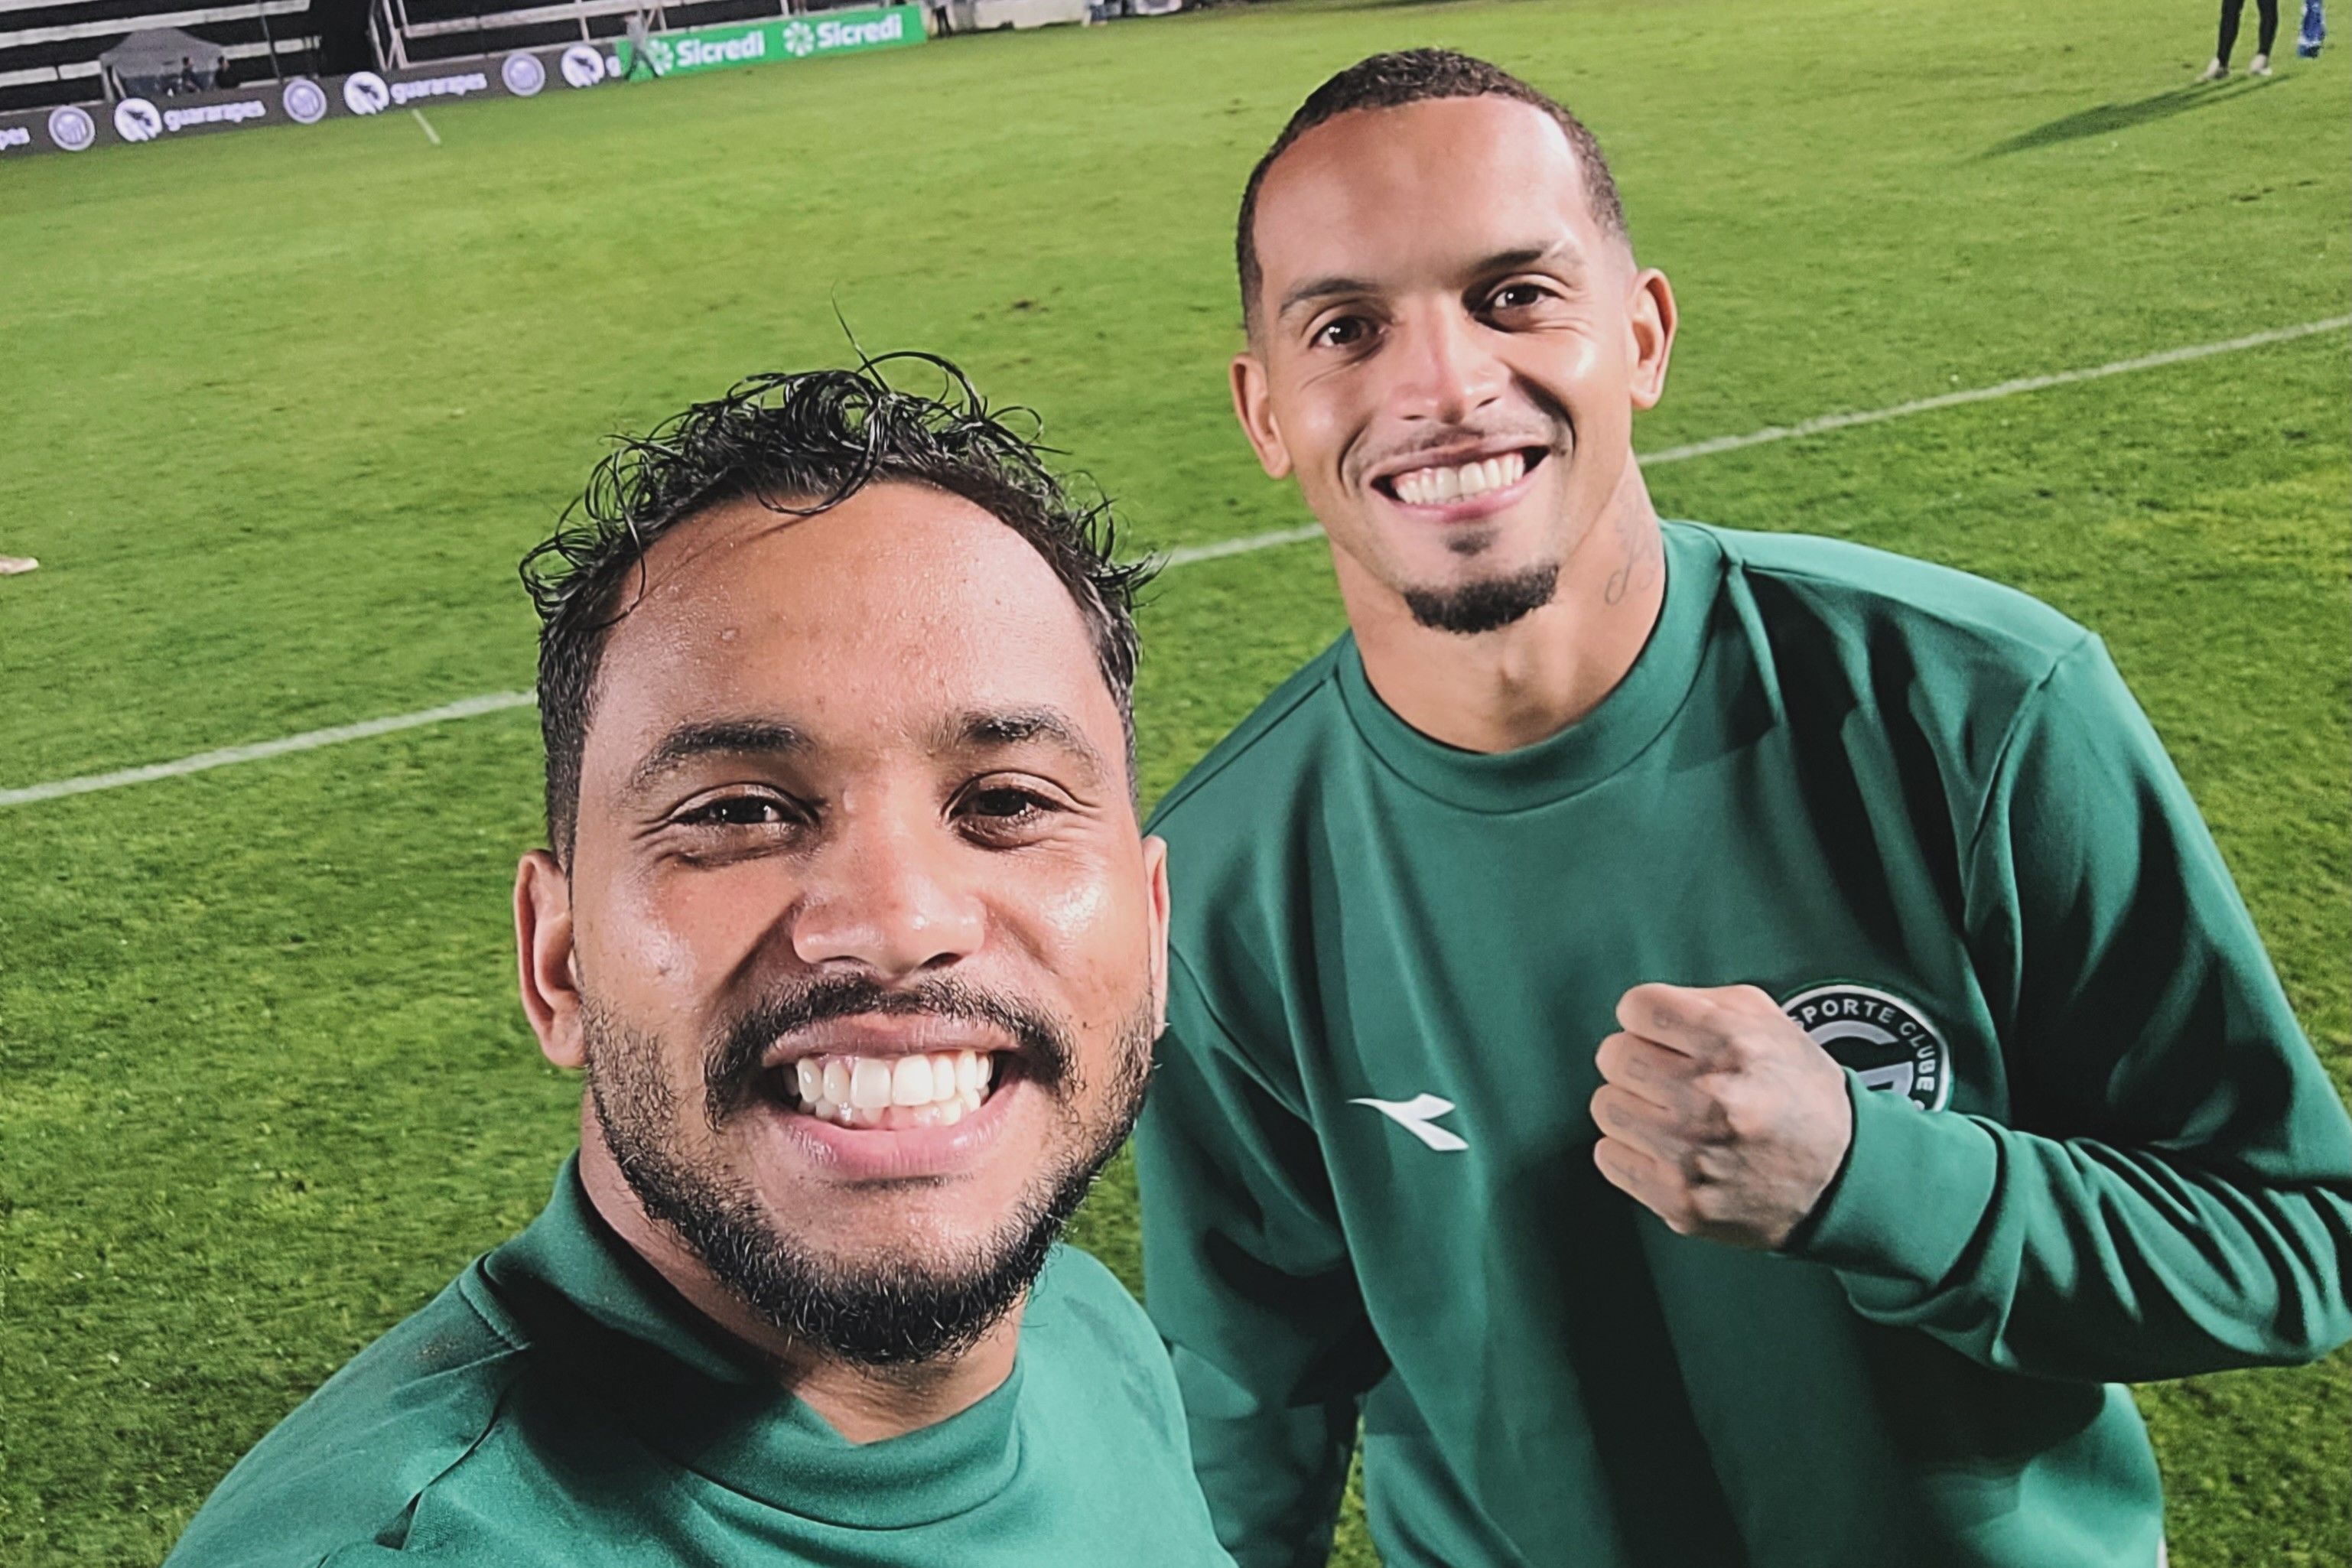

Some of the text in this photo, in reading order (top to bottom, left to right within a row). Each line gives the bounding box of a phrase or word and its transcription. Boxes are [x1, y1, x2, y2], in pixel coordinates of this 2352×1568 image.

[676, 31, 764, 67] Sicredi
[816, 15, 902, 47] Sicredi
[1900, 1021, 1936, 1091] CLUBE
